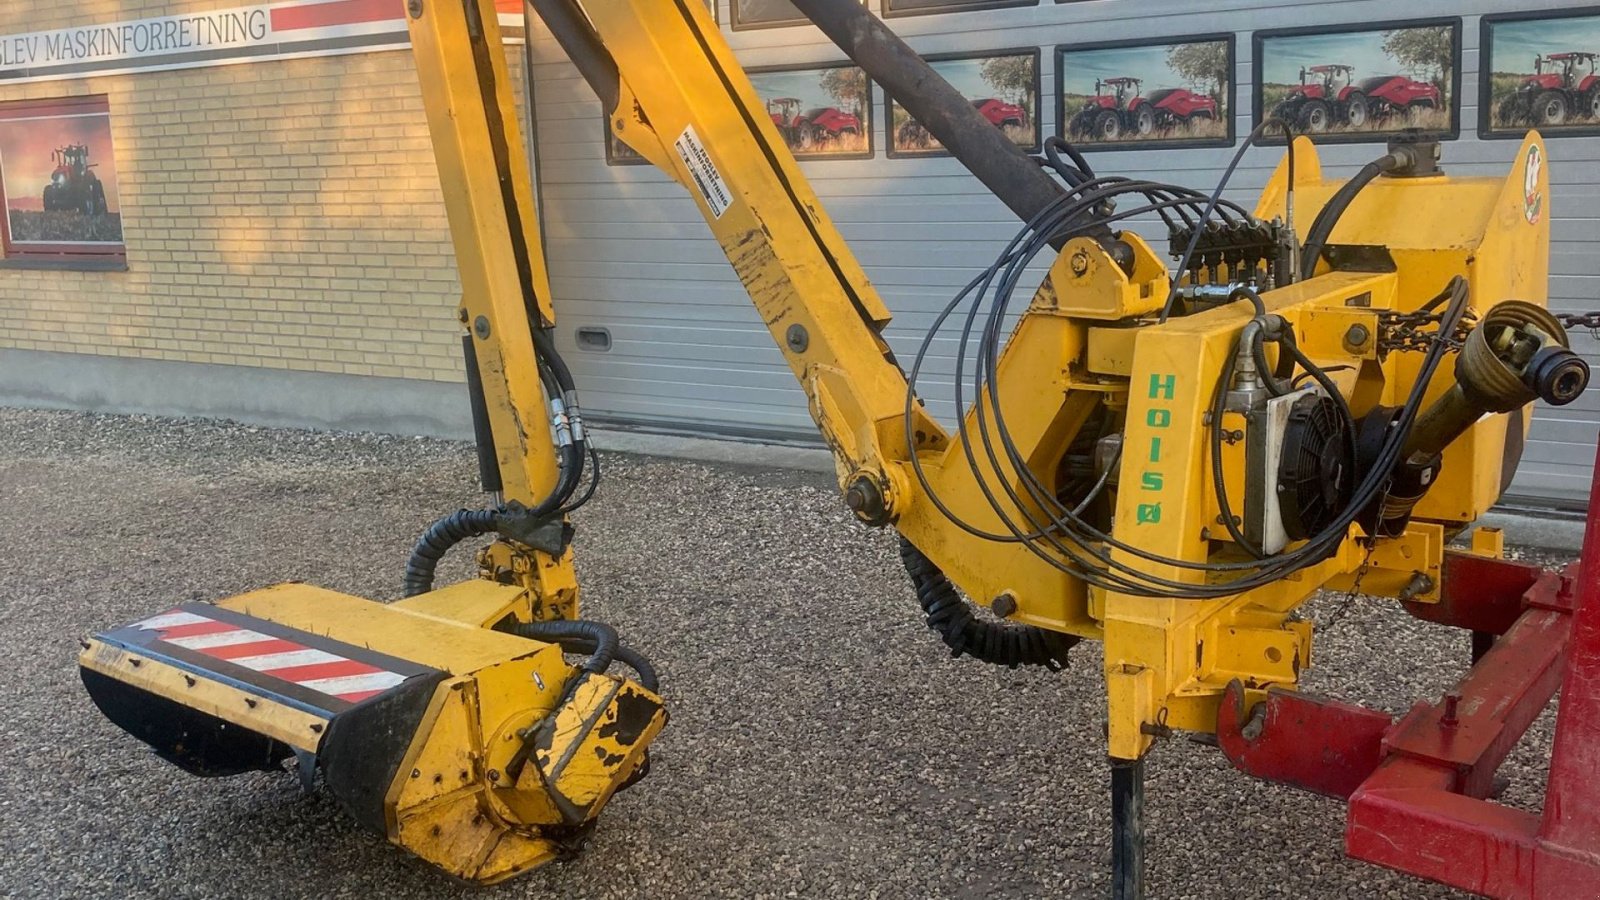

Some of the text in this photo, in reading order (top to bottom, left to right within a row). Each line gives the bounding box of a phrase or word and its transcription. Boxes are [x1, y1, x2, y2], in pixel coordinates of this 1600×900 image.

[0, 9, 266, 66] LEV MASKINFORRETNING
[683, 131, 728, 207] MASKINFORRETNING
[1136, 373, 1176, 526] HOISØ
